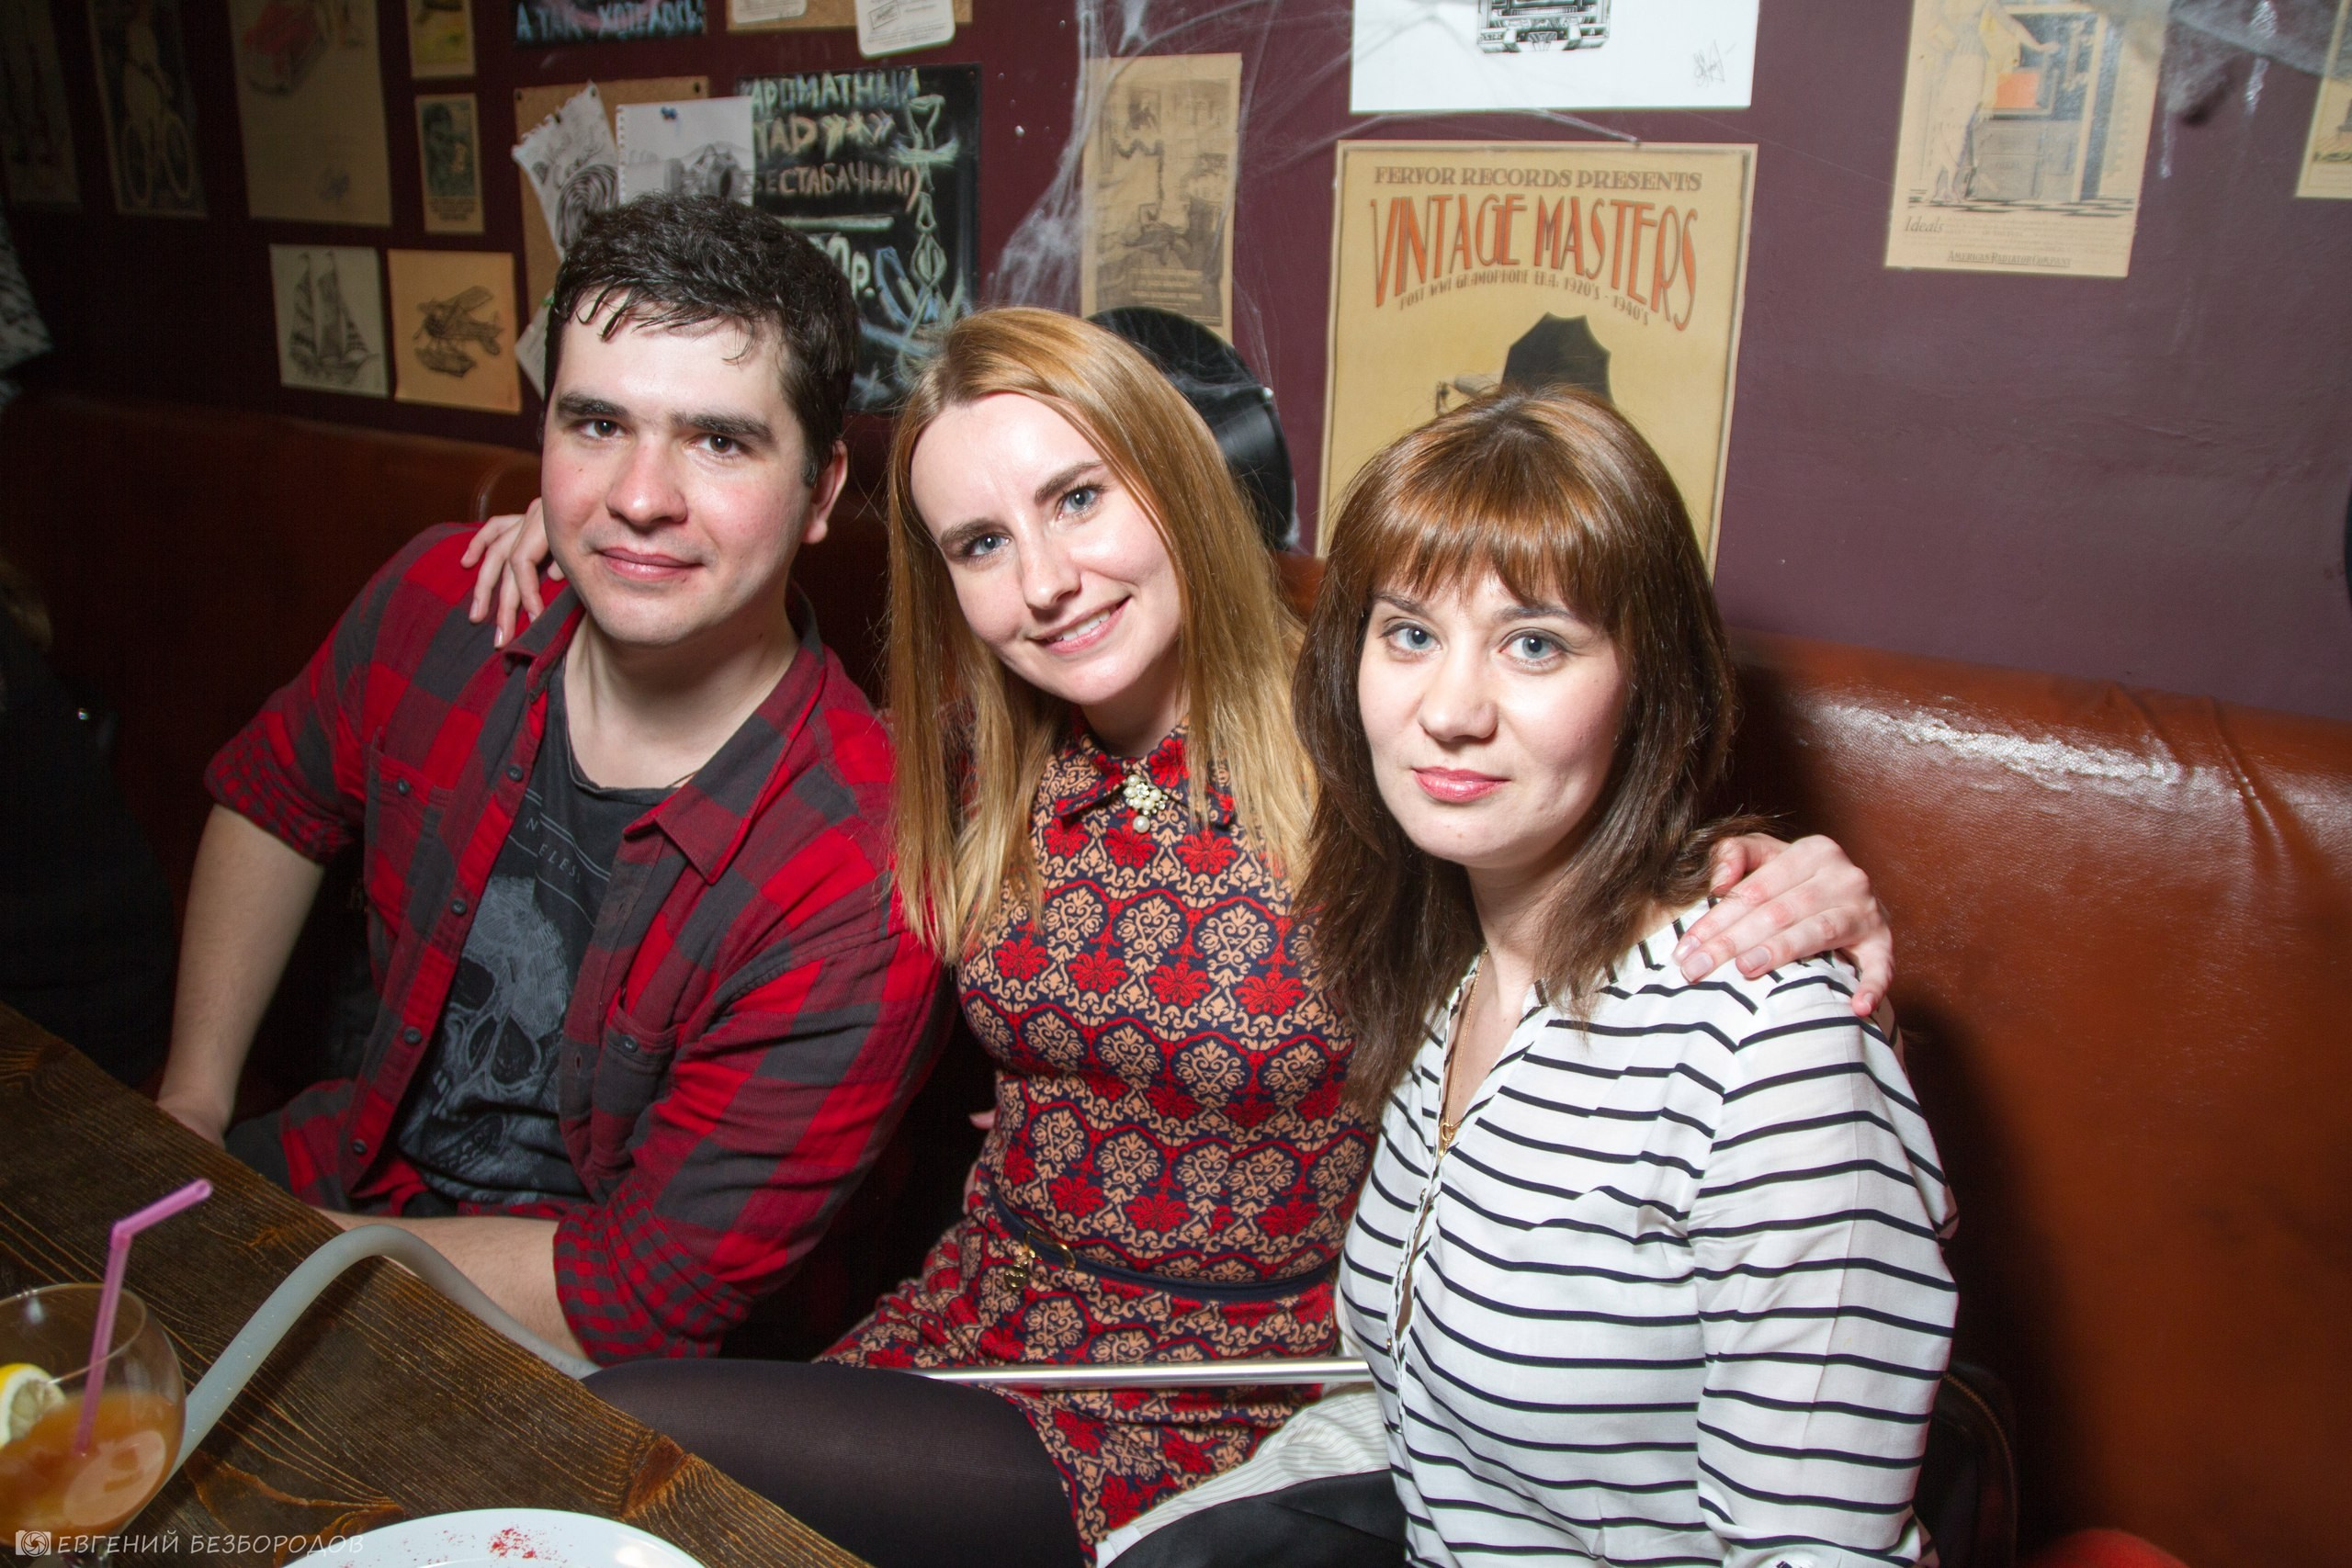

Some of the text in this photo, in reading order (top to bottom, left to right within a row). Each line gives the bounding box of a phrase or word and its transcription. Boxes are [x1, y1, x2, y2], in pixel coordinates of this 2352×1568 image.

[1374, 165, 1702, 192] FERVOR RECORDS PRESENTS
[1905, 215, 1944, 234] Ideals
[1370, 193, 1698, 332] VINTAGE MASTERS
[1399, 288, 1425, 311] POST
[1455, 268, 1530, 289] GRAMOPHONE
